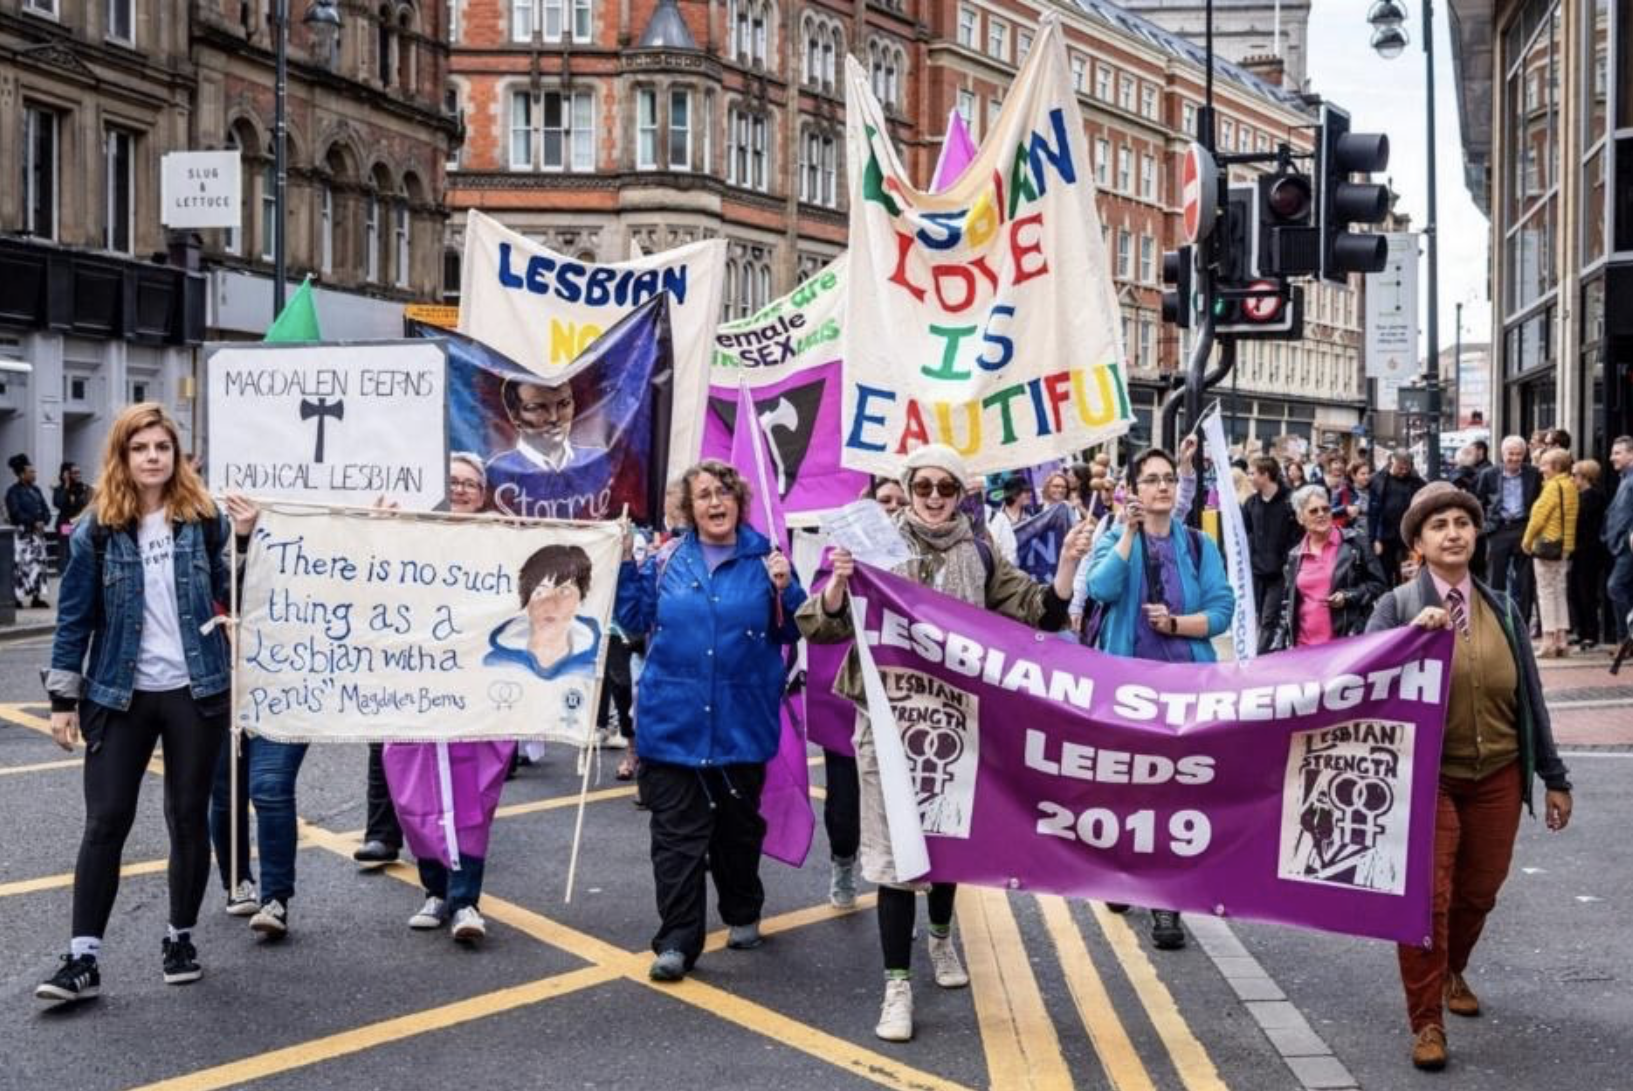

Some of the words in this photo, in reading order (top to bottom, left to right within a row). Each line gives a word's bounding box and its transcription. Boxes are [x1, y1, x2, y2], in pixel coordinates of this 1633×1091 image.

[188, 168, 218, 179] SLUG
[200, 182, 206, 192] &
[176, 196, 229, 207] LETTUCE
[498, 243, 688, 307] LESBIAN
[716, 313, 806, 348] emale
[920, 305, 1017, 380] IS
[225, 369, 348, 397] MAGDALEN
[361, 369, 433, 397] BERNS
[226, 463, 318, 490] RADICAL
[330, 464, 422, 493] LESBIAN
[366, 555, 391, 582] is
[400, 560, 437, 585] no
[442, 563, 512, 595] such
[270, 587, 353, 641] thing
[369, 603, 411, 635] as
[432, 605, 463, 641] a
[246, 629, 374, 674] Lesbian
[852, 596, 1094, 710] LESBIAN
[1113, 658, 1443, 726] STRENGTH
[890, 701, 967, 732] TRENGTH
[1306, 722, 1397, 755] LESBIAN
[1024, 728, 1216, 785] LEEDS
[1299, 747, 1399, 779] STRENGTH
[1036, 801, 1212, 857] 2019
